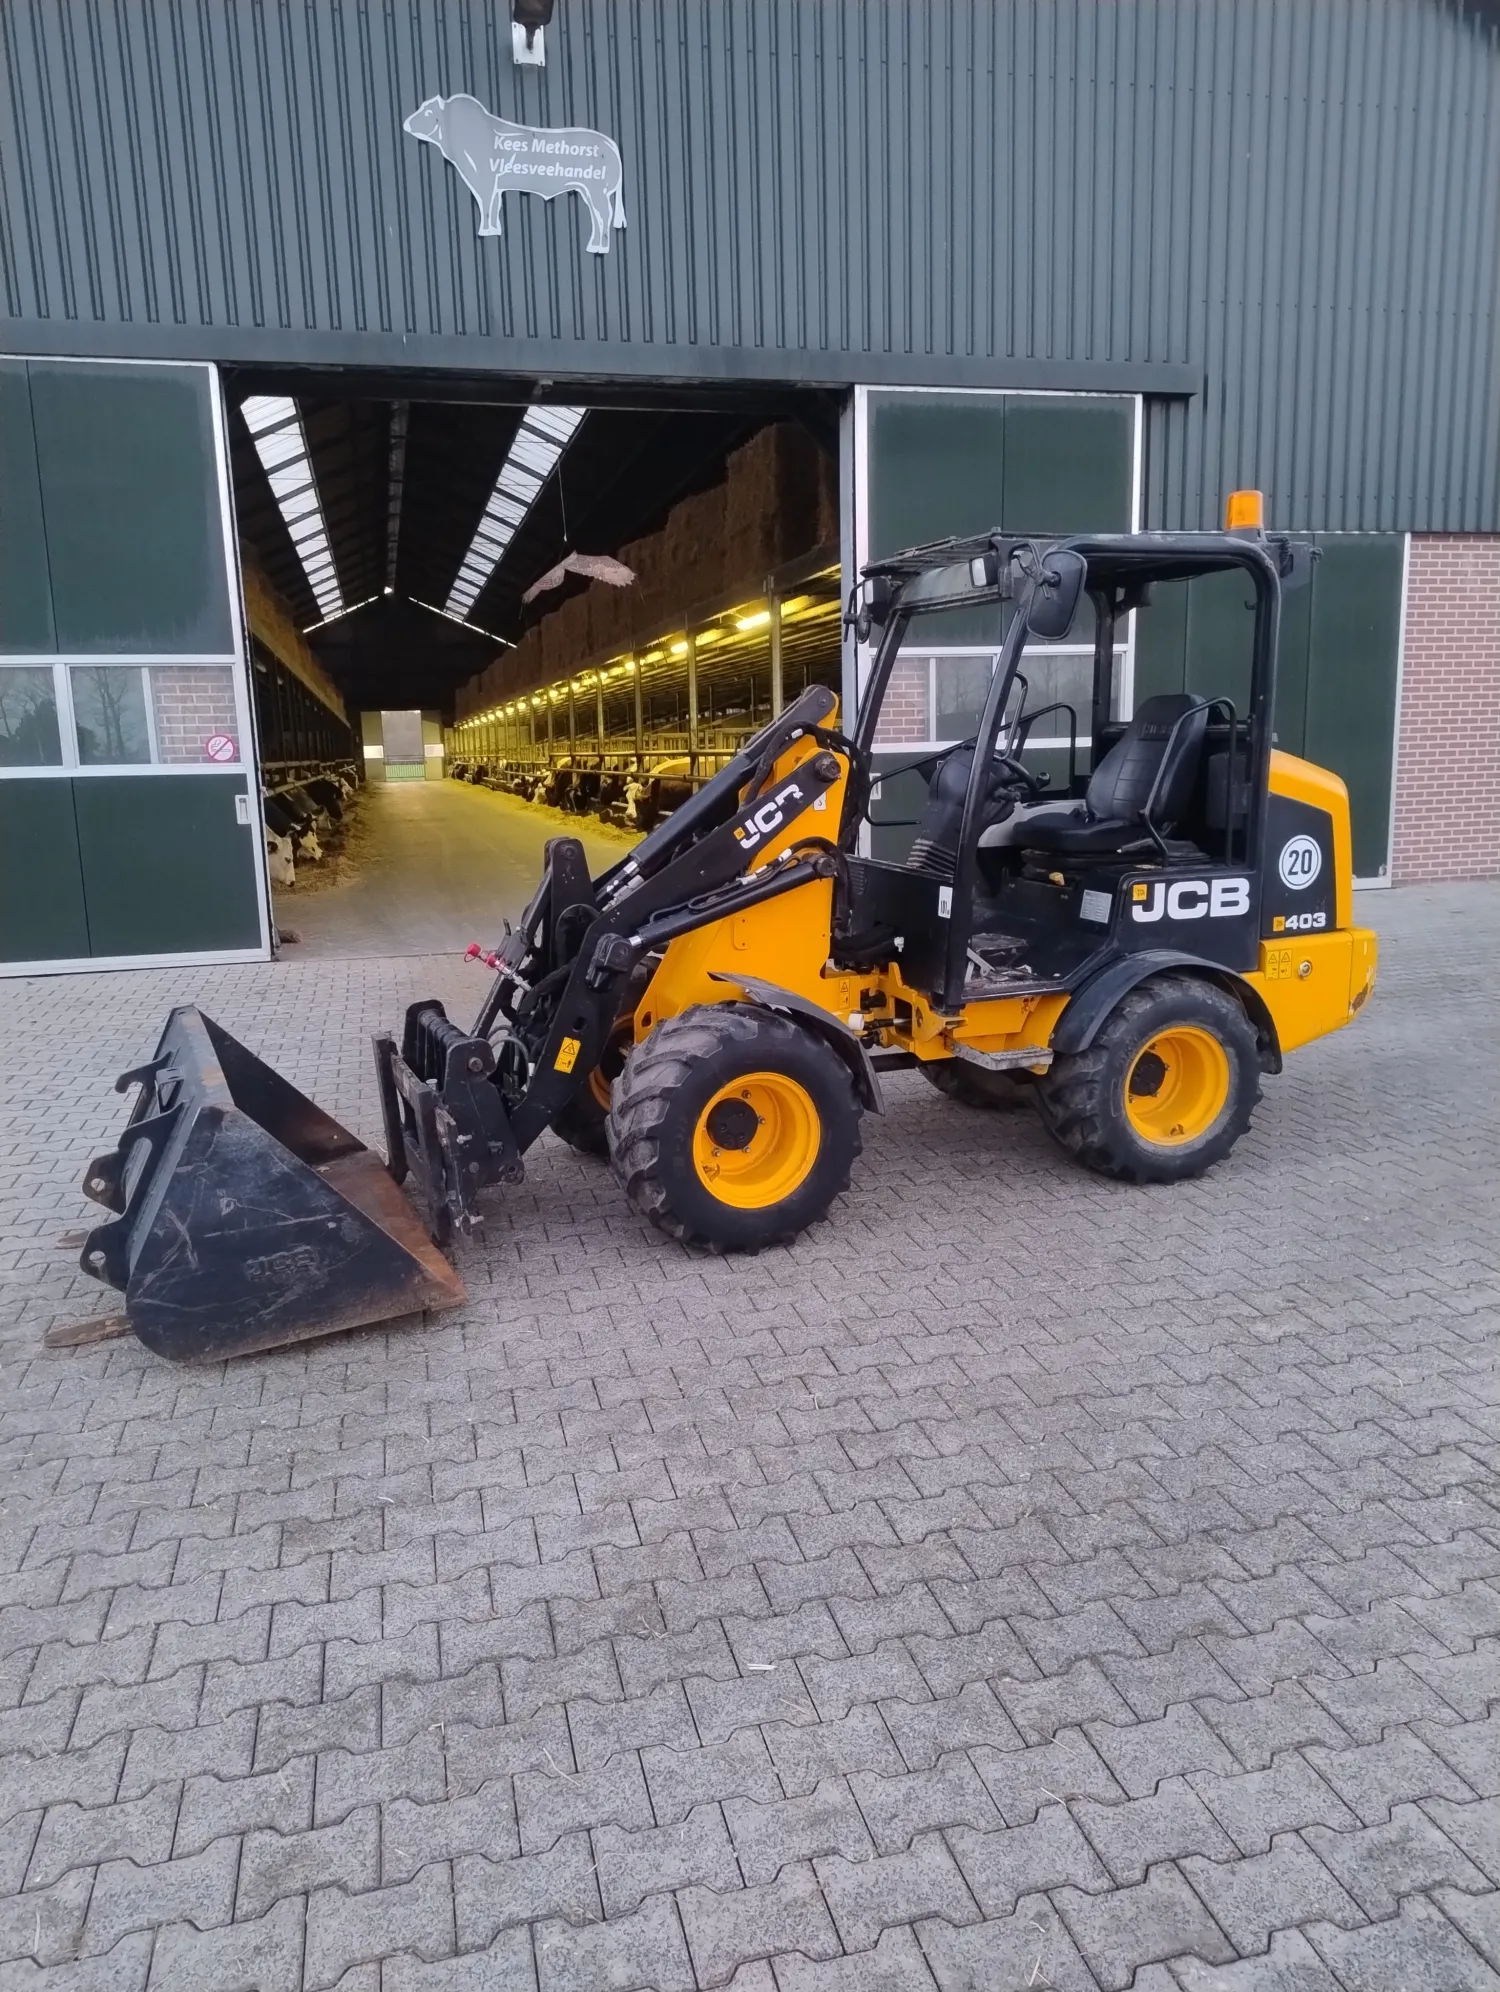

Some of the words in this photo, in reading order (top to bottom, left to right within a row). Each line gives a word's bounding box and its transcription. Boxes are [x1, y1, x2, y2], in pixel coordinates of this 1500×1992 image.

[494, 135, 528, 152] Kees
[531, 138, 600, 158] Methorst
[489, 157, 607, 180] Vleesveehandel
[1287, 848, 1313, 876] 20
[1132, 877, 1250, 923] JCB
[1285, 912, 1327, 930] 403
